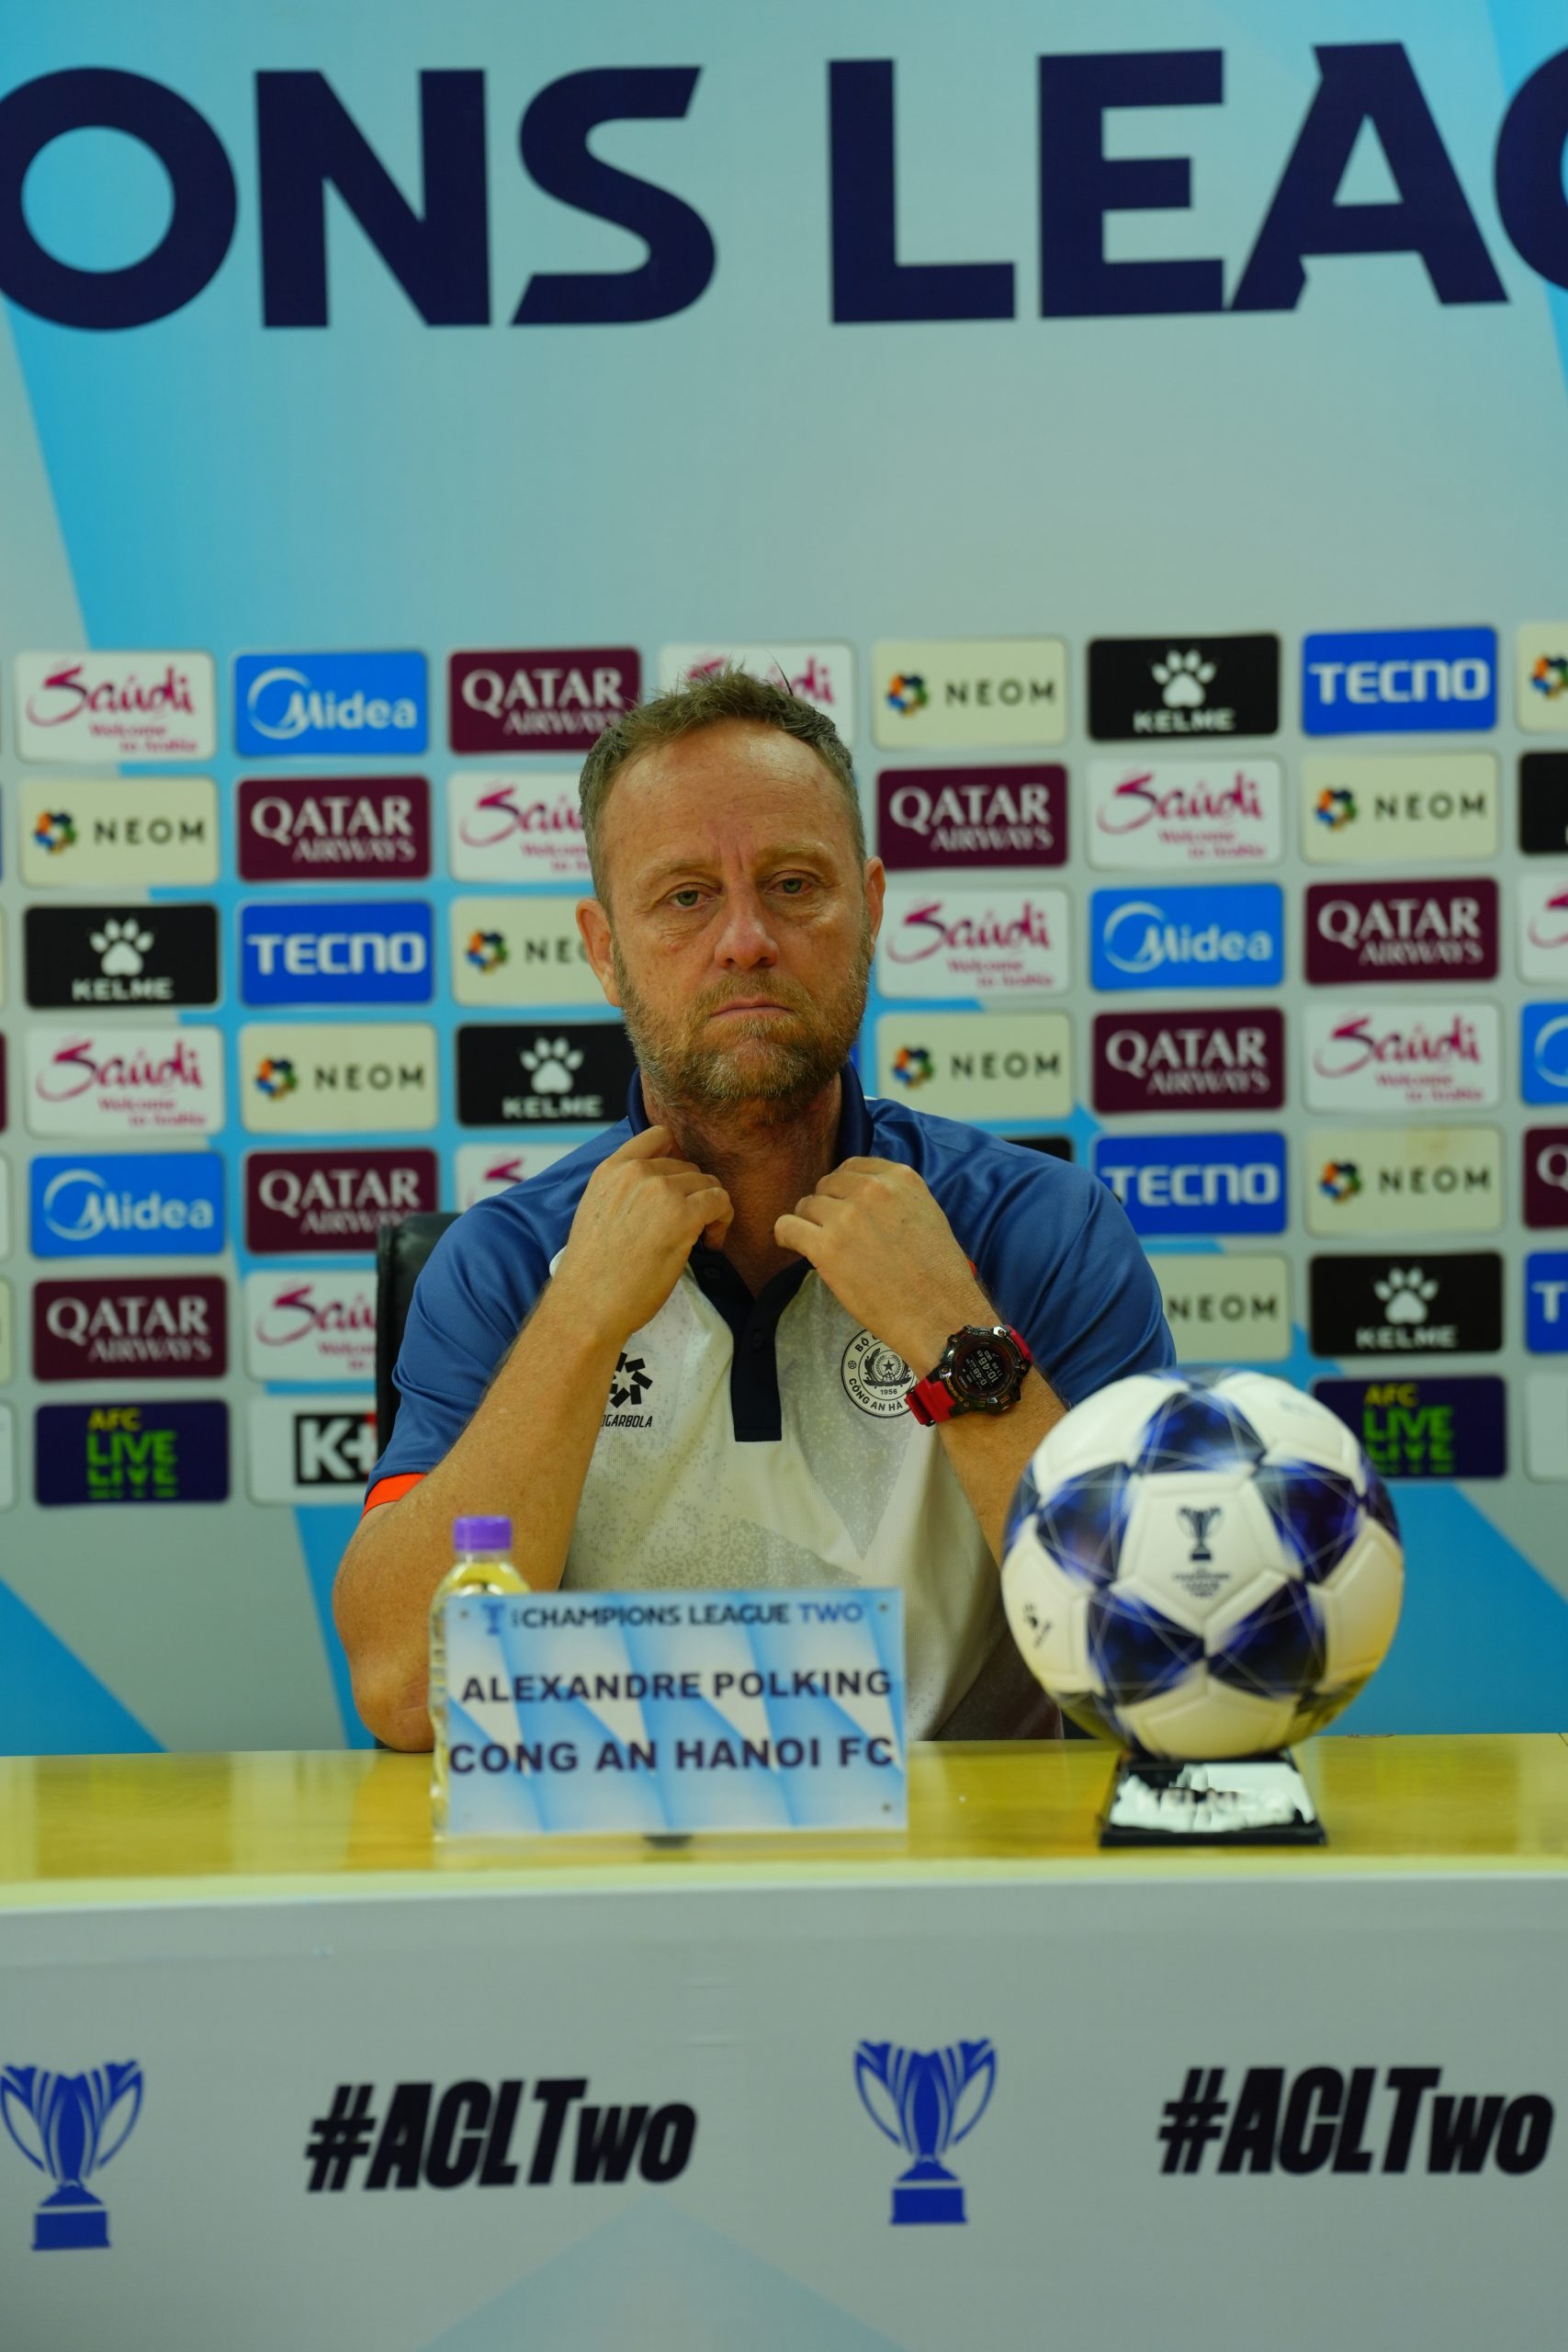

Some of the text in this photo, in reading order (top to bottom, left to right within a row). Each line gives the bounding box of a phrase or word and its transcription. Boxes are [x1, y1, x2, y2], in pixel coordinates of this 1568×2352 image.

[461, 668, 624, 718] QATAR
[945, 680, 1056, 706] NEOM
[1309, 659, 1490, 705] TECNO
[248, 667, 418, 740] Midea
[503, 708, 623, 735] AIRWAY
[1134, 708, 1235, 732] KELME
[251, 796, 413, 844] QATAR
[889, 784, 1051, 833] QATAR
[1374, 793, 1486, 820] NEOM
[94, 819, 206, 844] NEOM
[931, 827, 1054, 853] AIRWAYS
[293, 837, 416, 863] AIRWAYS
[1103, 901, 1273, 974] Midea
[1316, 897, 1480, 949] QATAR
[248, 933, 426, 975] TECNO
[525, 936, 590, 963] NE
[1358, 940, 1483, 967] AIRWAYS
[73, 978, 174, 1001] KELME
[950, 1051, 1061, 1080] NEOM
[1105, 1027, 1267, 1079] QATAR
[314, 1066, 425, 1092] NEOM
[1146, 1069, 1269, 1095] AIRWAYS
[502, 1096, 603, 1119] KELME
[258, 1169, 421, 1218] QATAR
[1101, 1163, 1280, 1206] TECNO
[1379, 1168, 1491, 1193] NEOM
[43, 1169, 214, 1240] Midea
[47, 1296, 209, 1346] QATAR
[1167, 1293, 1279, 1321] NEOM
[89, 1336, 212, 1363] AIRWAYS
[1355, 1325, 1458, 1349] KELME
[849, 1378, 870, 1404] CÔNG
[870, 1401, 886, 1411] AN
[1364, 1382, 1419, 1408] AFC
[88, 1407, 141, 1431] AFC
[1364, 1405, 1453, 1442] LIVE
[87, 1430, 177, 1465] LIVE
[522, 1606, 681, 1628] CHAMPIONS
[690, 1602, 790, 1626] LEAGUE
[798, 1601, 863, 1623] TWO
[462, 1669, 892, 1703] ALEXANDRE POLKING
[448, 1736, 893, 1774] CONG AN HANOI FC
[304, 2077, 697, 2193] #ACLTwo
[1158, 2064, 1554, 2177] #ACLTwo
